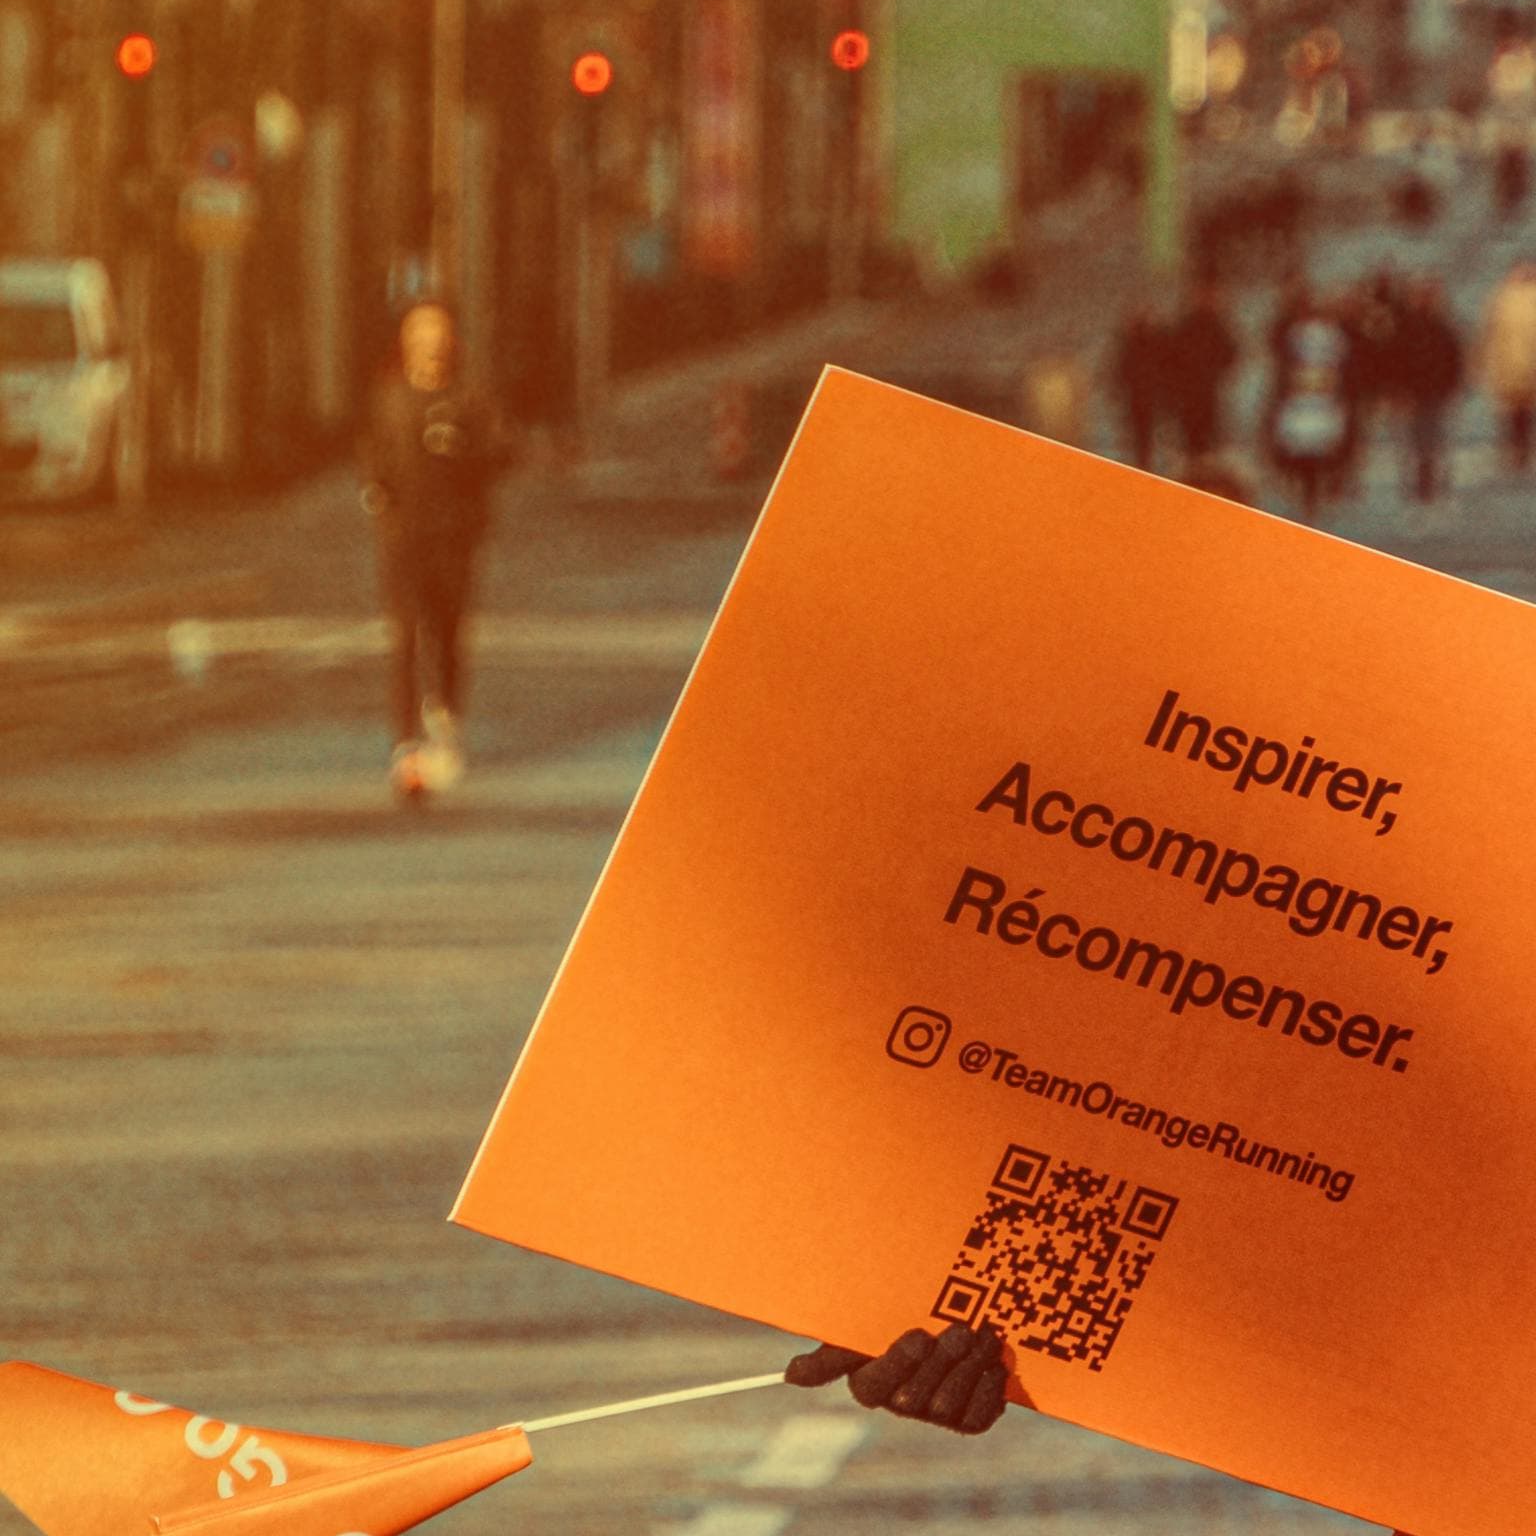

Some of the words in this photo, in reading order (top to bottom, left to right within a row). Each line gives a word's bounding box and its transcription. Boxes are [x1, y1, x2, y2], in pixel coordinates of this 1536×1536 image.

[1143, 689, 1403, 837] Inspirer,
[975, 761, 1454, 975] Accompagner,
[943, 866, 1416, 1073] Récompenser.
[958, 1040, 1357, 1203] @TeamOrangeRunning
